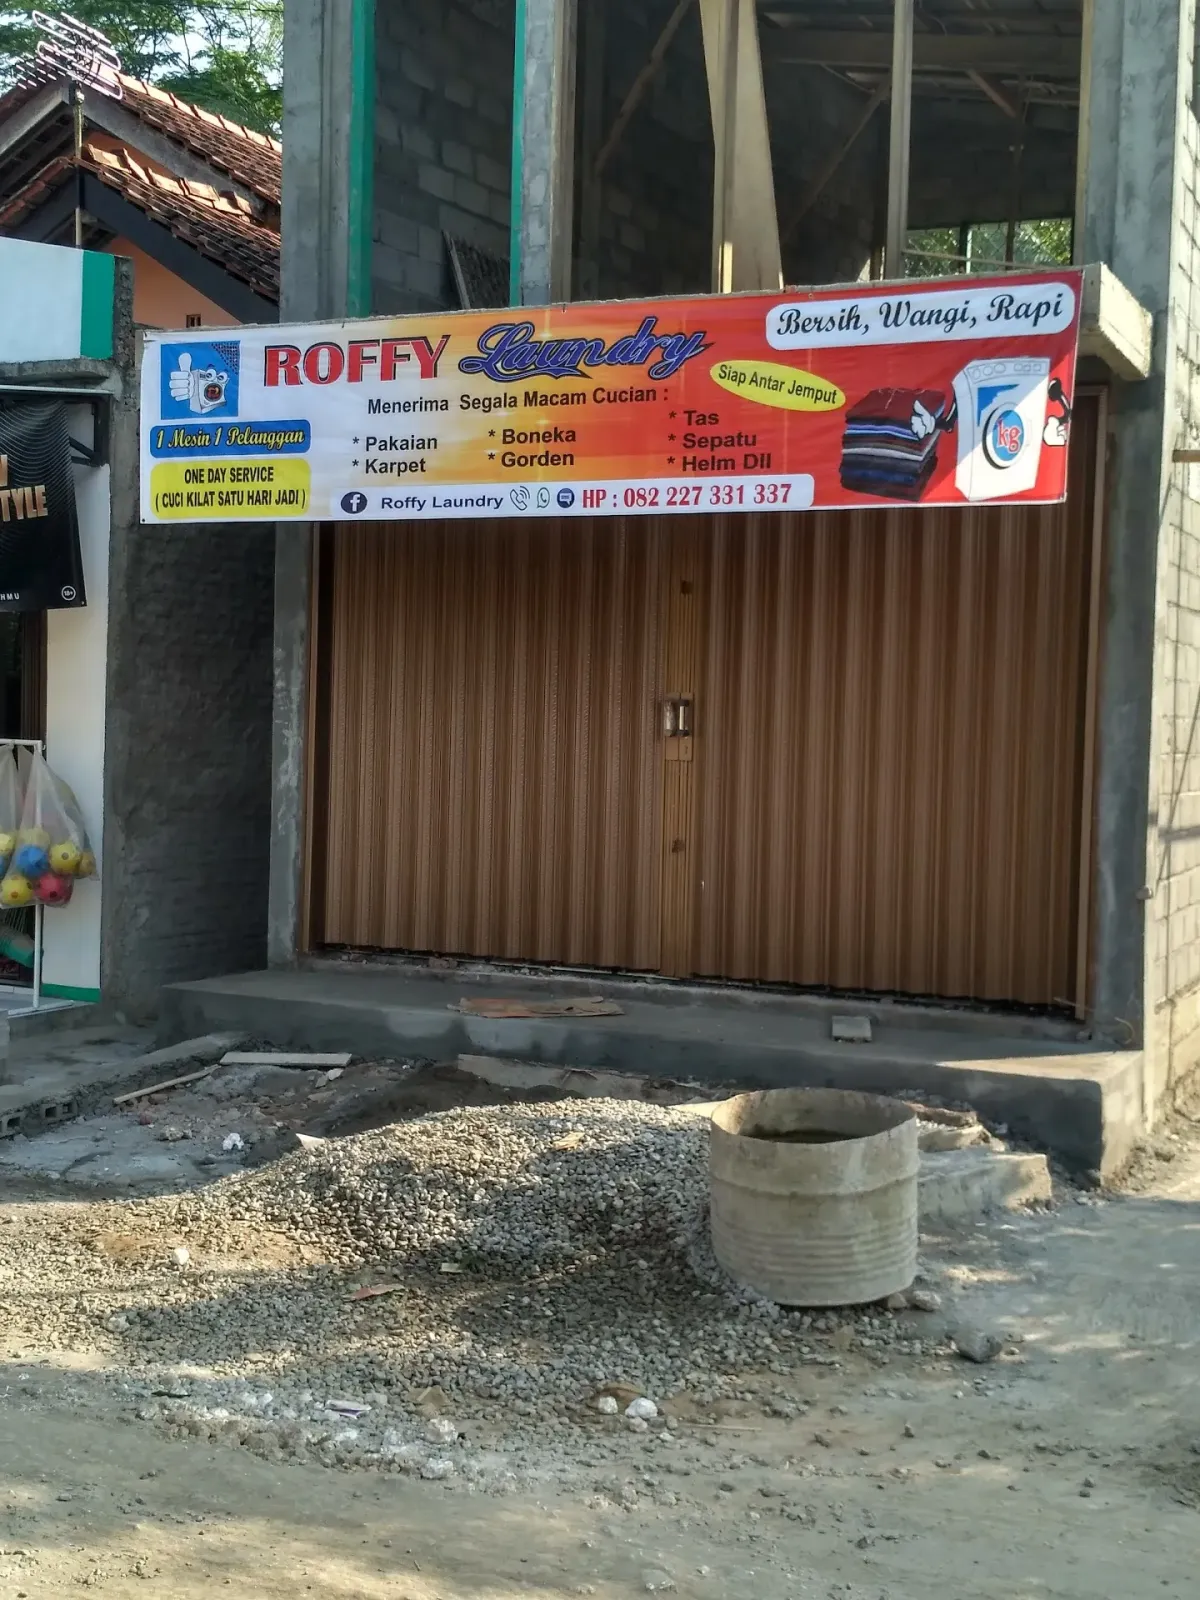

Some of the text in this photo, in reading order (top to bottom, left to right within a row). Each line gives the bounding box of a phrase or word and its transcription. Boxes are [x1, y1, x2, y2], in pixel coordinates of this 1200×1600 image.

[776, 292, 1064, 336] Bersih, Wangi, Rapi
[458, 316, 714, 383] Laundry
[264, 335, 450, 387] ROFFY
[718, 364, 839, 406] Siap Antar Jemput
[367, 398, 449, 415] Menerima
[459, 392, 518, 413] Segala
[523, 389, 587, 408] Macam
[683, 410, 720, 426] Tas
[156, 425, 305, 452] 1 Mesin 1 Pelanggan
[365, 435, 439, 453] Pakaian
[502, 427, 577, 445] Boneka
[682, 431, 758, 452] Sepatu
[997, 419, 1022, 453] kg
[365, 458, 427, 478] Karpet
[501, 450, 575, 468] Gorden
[682, 453, 772, 473] Helm Dll
[184, 466, 274, 485] ONE DAY SERVICE
[186, 492, 216, 508] KILAT
[218, 491, 244, 506] SATU
[248, 490, 272, 505] HARI
[381, 495, 503, 511] Roffy Laundry
[623, 488, 659, 507] 082
[666, 486, 702, 505] 227
[709, 485, 744, 504] 331
[753, 484, 792, 503] 337
